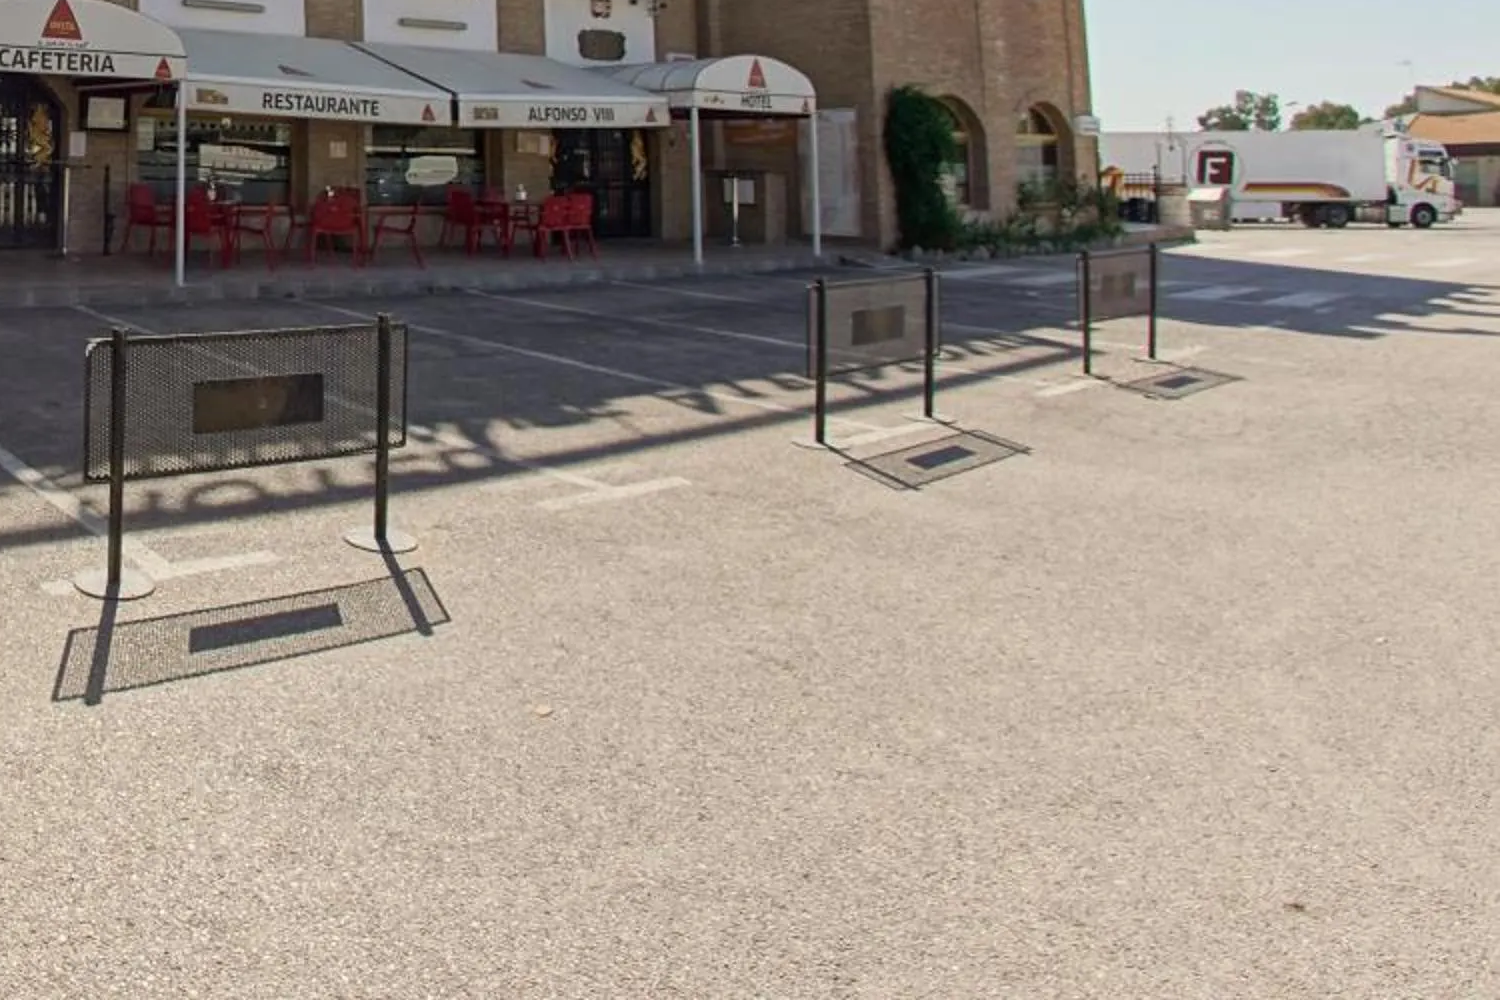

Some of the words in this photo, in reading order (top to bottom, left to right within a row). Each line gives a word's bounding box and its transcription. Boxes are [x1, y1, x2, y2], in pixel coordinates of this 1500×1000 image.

[262, 92, 380, 117] RESTAURANTE
[741, 94, 773, 109] HOTEL
[528, 107, 588, 121] ALFONSO
[593, 107, 615, 122] VIII
